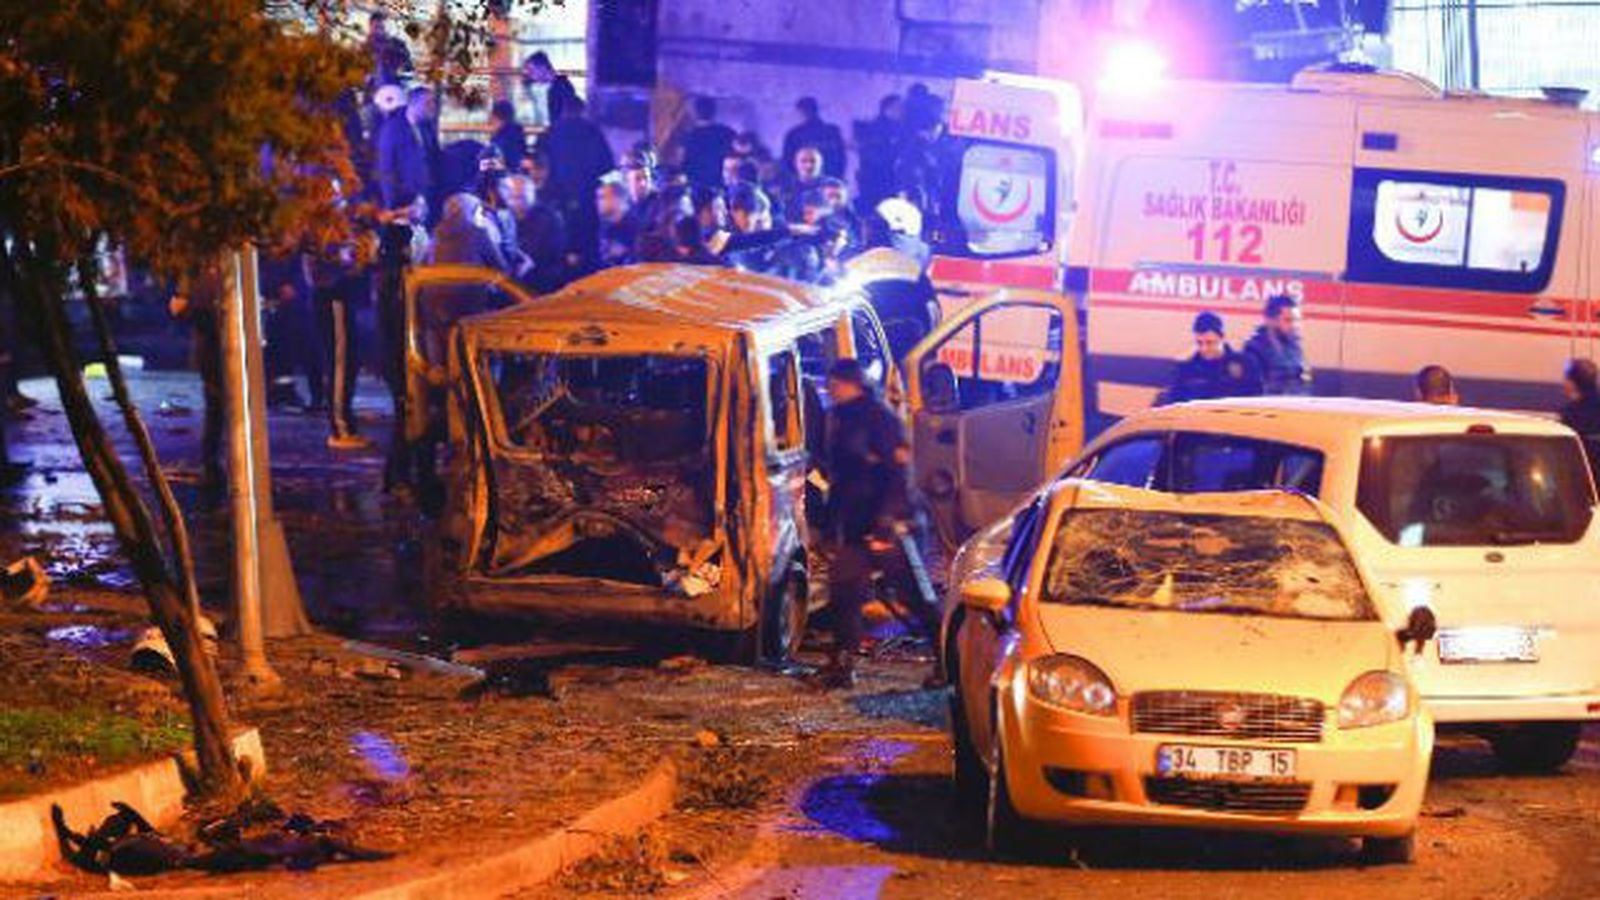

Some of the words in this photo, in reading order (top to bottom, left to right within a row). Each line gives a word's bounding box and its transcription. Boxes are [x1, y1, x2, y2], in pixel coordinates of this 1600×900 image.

[1143, 190, 1206, 221] SAĞLIK
[1187, 223, 1263, 263] 112
[1128, 270, 1304, 303] AMBULANS
[1173, 748, 1196, 769] 34
[1216, 749, 1252, 772] TBP
[1267, 752, 1288, 774] 15
